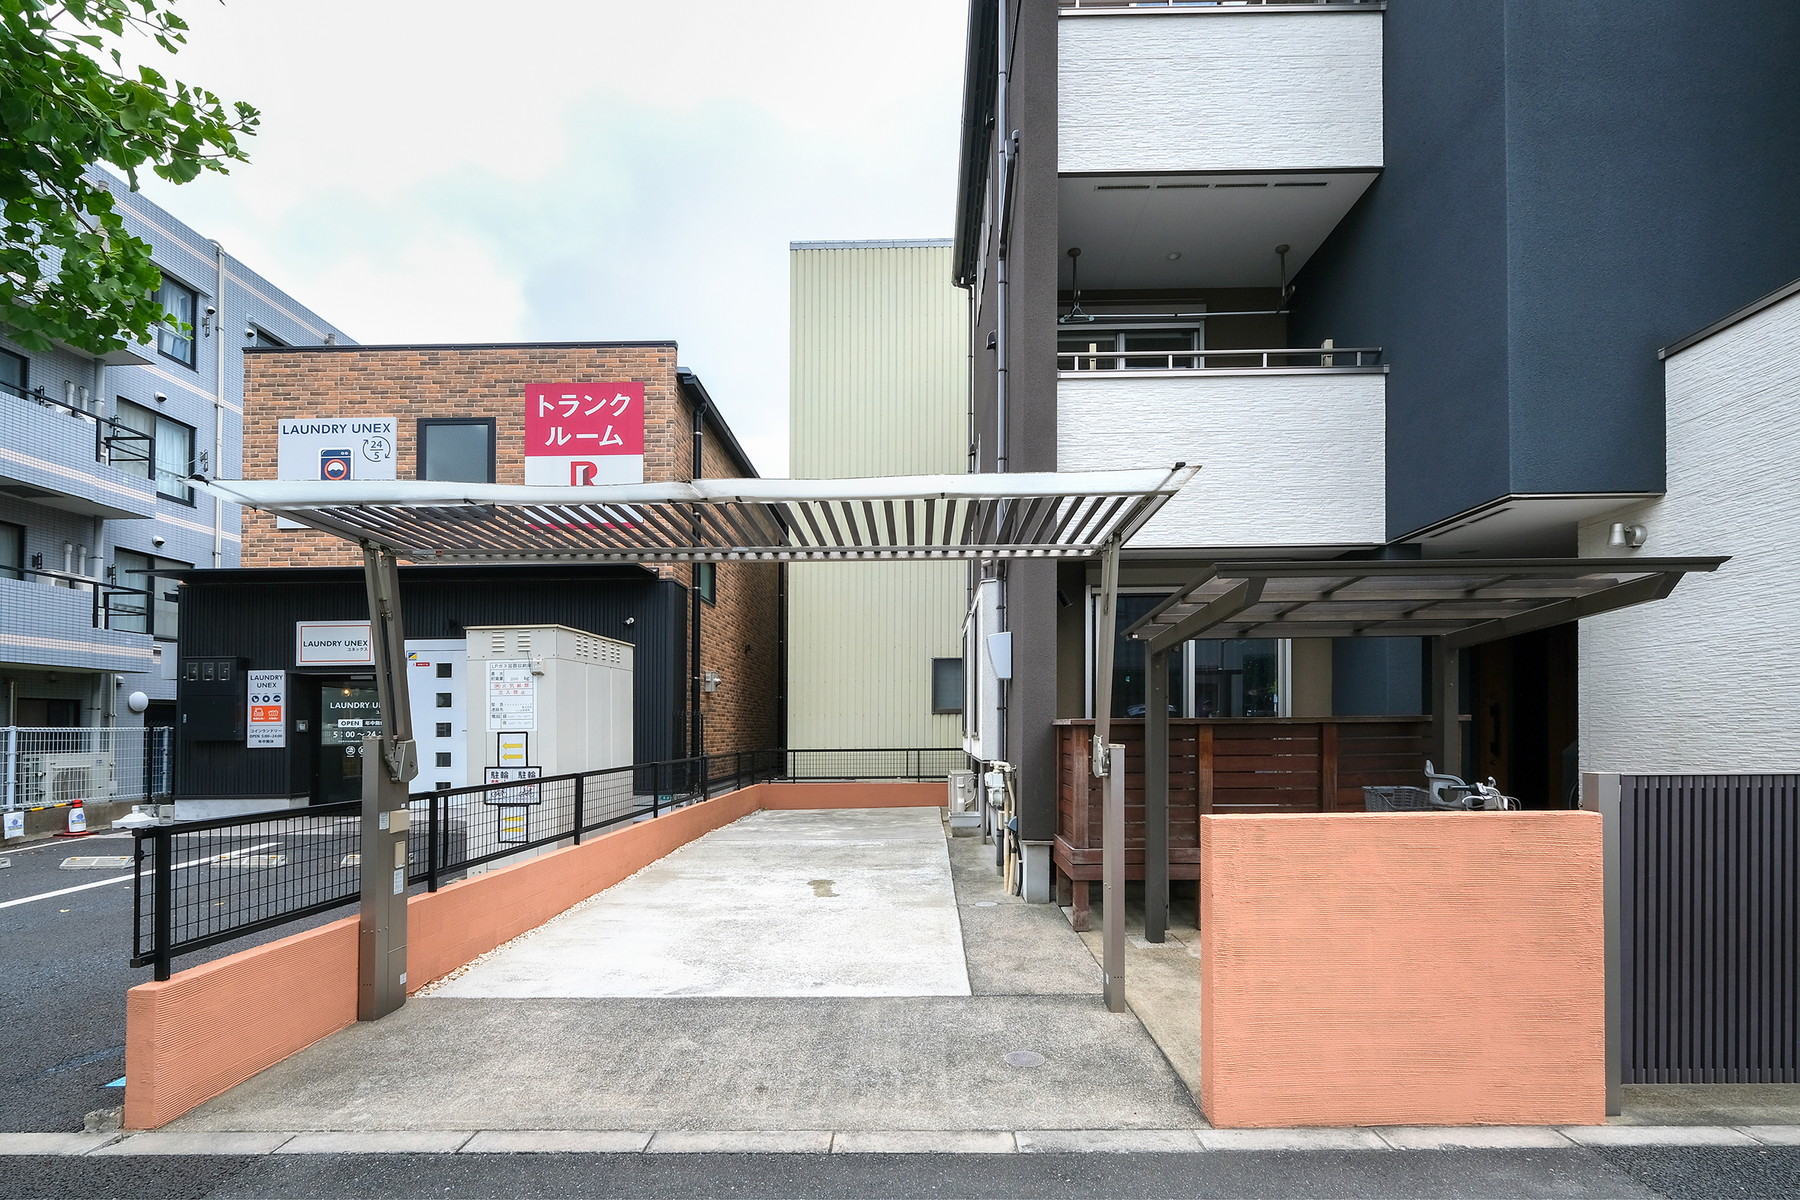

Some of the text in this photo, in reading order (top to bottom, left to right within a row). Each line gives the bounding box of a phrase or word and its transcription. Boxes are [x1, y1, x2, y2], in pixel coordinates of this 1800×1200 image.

[538, 392, 631, 418] トランク
[282, 423, 391, 435] LAUNDRY UNEX
[544, 424, 624, 447] ルーム
[370, 440, 383, 449] 24
[373, 451, 380, 460] 5
[344, 639, 368, 647] UNEX
[490, 771, 509, 779] 駐輪
[517, 771, 536, 779] 駐輪
